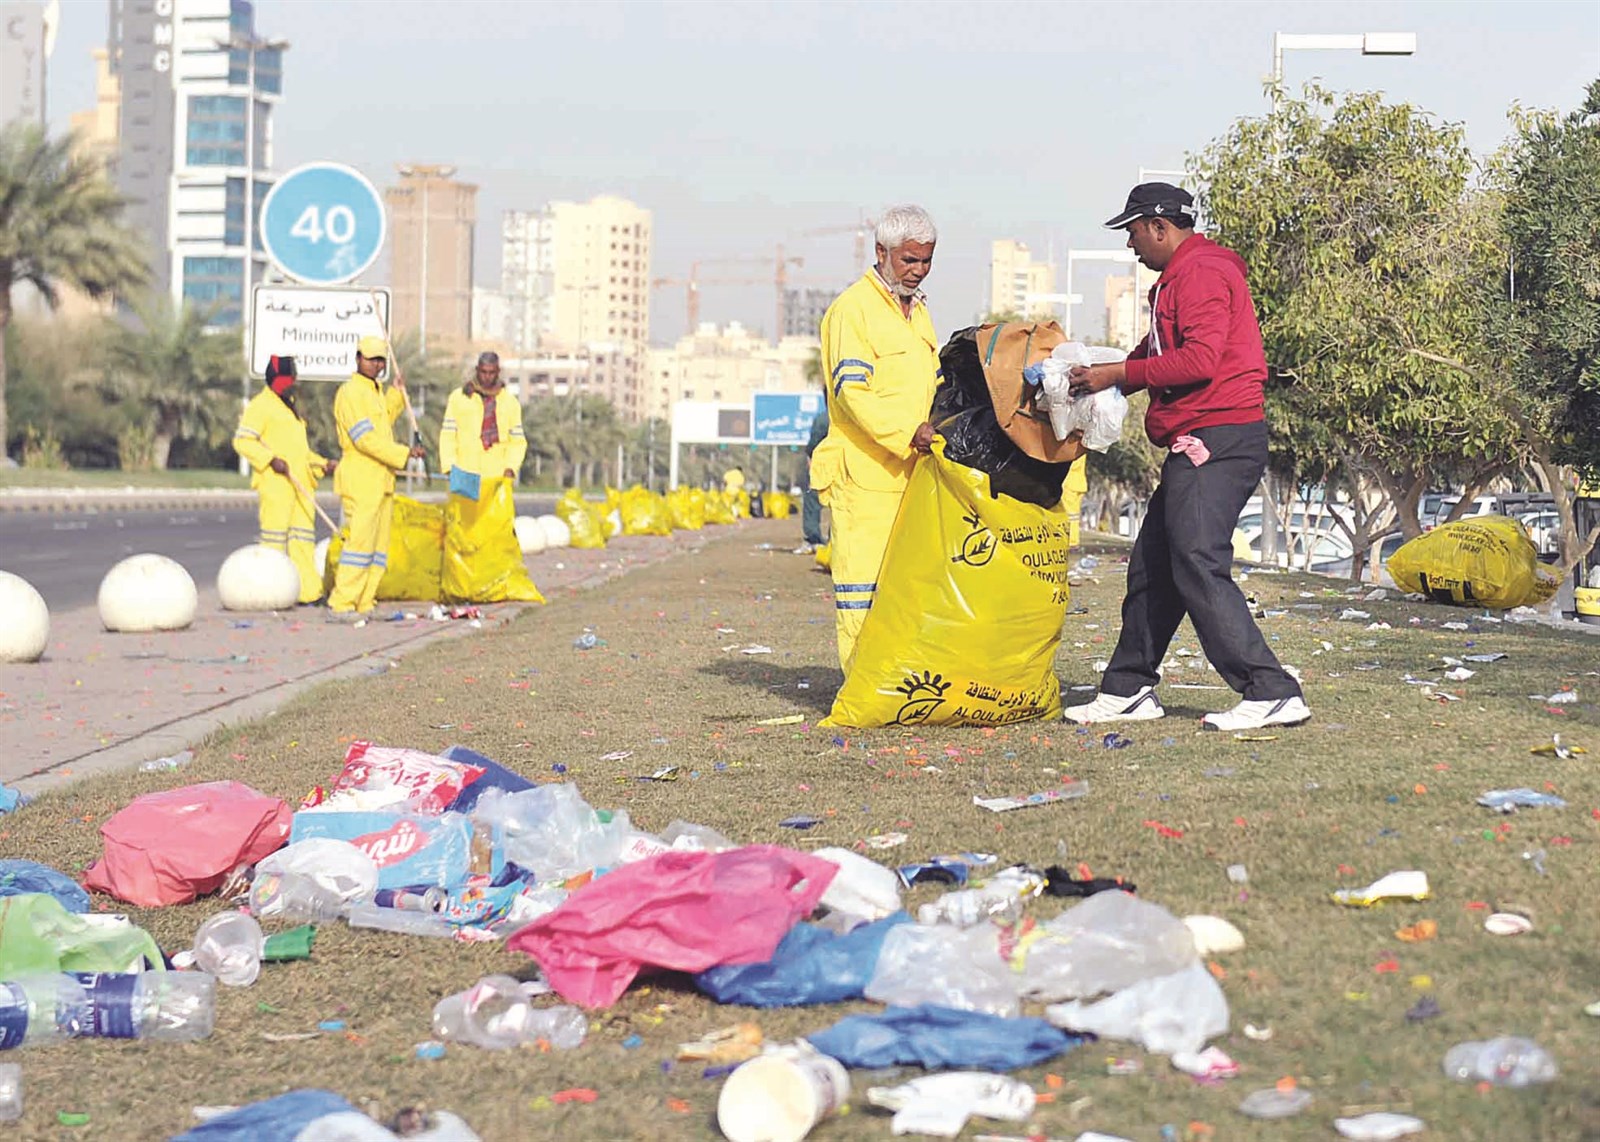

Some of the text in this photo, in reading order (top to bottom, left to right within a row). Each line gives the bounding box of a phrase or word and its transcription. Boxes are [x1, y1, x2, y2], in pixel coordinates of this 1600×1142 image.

[290, 204, 356, 245] 40
[282, 327, 361, 343] Minimum
[952, 706, 969, 718] AL
[971, 709, 1004, 722] OULA
